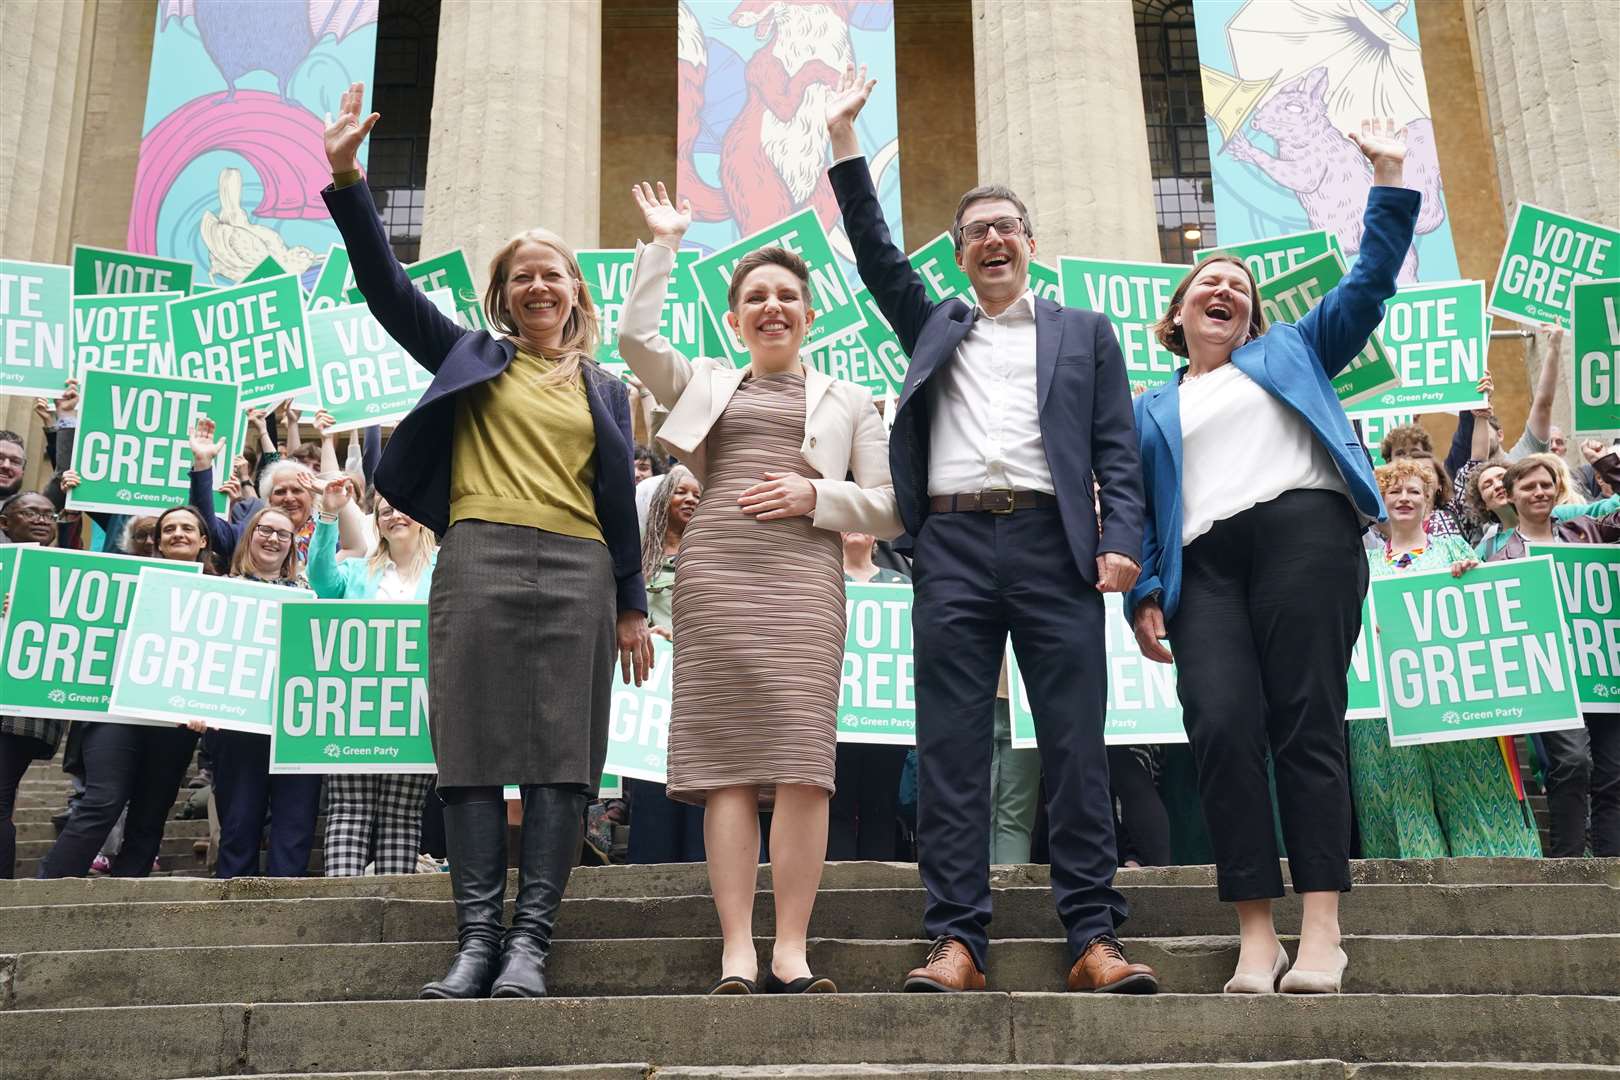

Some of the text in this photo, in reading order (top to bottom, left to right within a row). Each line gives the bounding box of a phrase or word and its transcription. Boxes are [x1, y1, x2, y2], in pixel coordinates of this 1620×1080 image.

[1532, 220, 1613, 277] VOTE
[0, 273, 44, 318] TE
[95, 260, 173, 294] VOTE
[1083, 272, 1171, 321] VOTE
[1502, 254, 1593, 311] GRE
[74, 305, 159, 343] VOTE
[191, 290, 281, 346] VOTE
[333, 315, 388, 356] VO
[76, 341, 178, 384] REEN
[180, 326, 305, 386] GREEN
[322, 350, 429, 405] GREE
[1384, 337, 1478, 389] EEN
[254, 383, 275, 393] Party
[1396, 392, 1444, 402] Green Party
[133, 492, 185, 505] Green Party
[49, 566, 140, 625] VOT
[169, 586, 278, 646] VOTE
[1402, 578, 1529, 643] VOTE
[6, 620, 128, 687] GRE
[309, 618, 422, 673] VOTE
[1388, 631, 1566, 709] GREEN
[68, 692, 99, 704] Green
[838, 652, 915, 710] REE
[186, 698, 247, 717] Green Party
[282, 676, 431, 738] GREEN
[860, 716, 915, 729] Green Party
[1462, 706, 1524, 721] Green Party
[342, 745, 399, 758] Green Party
